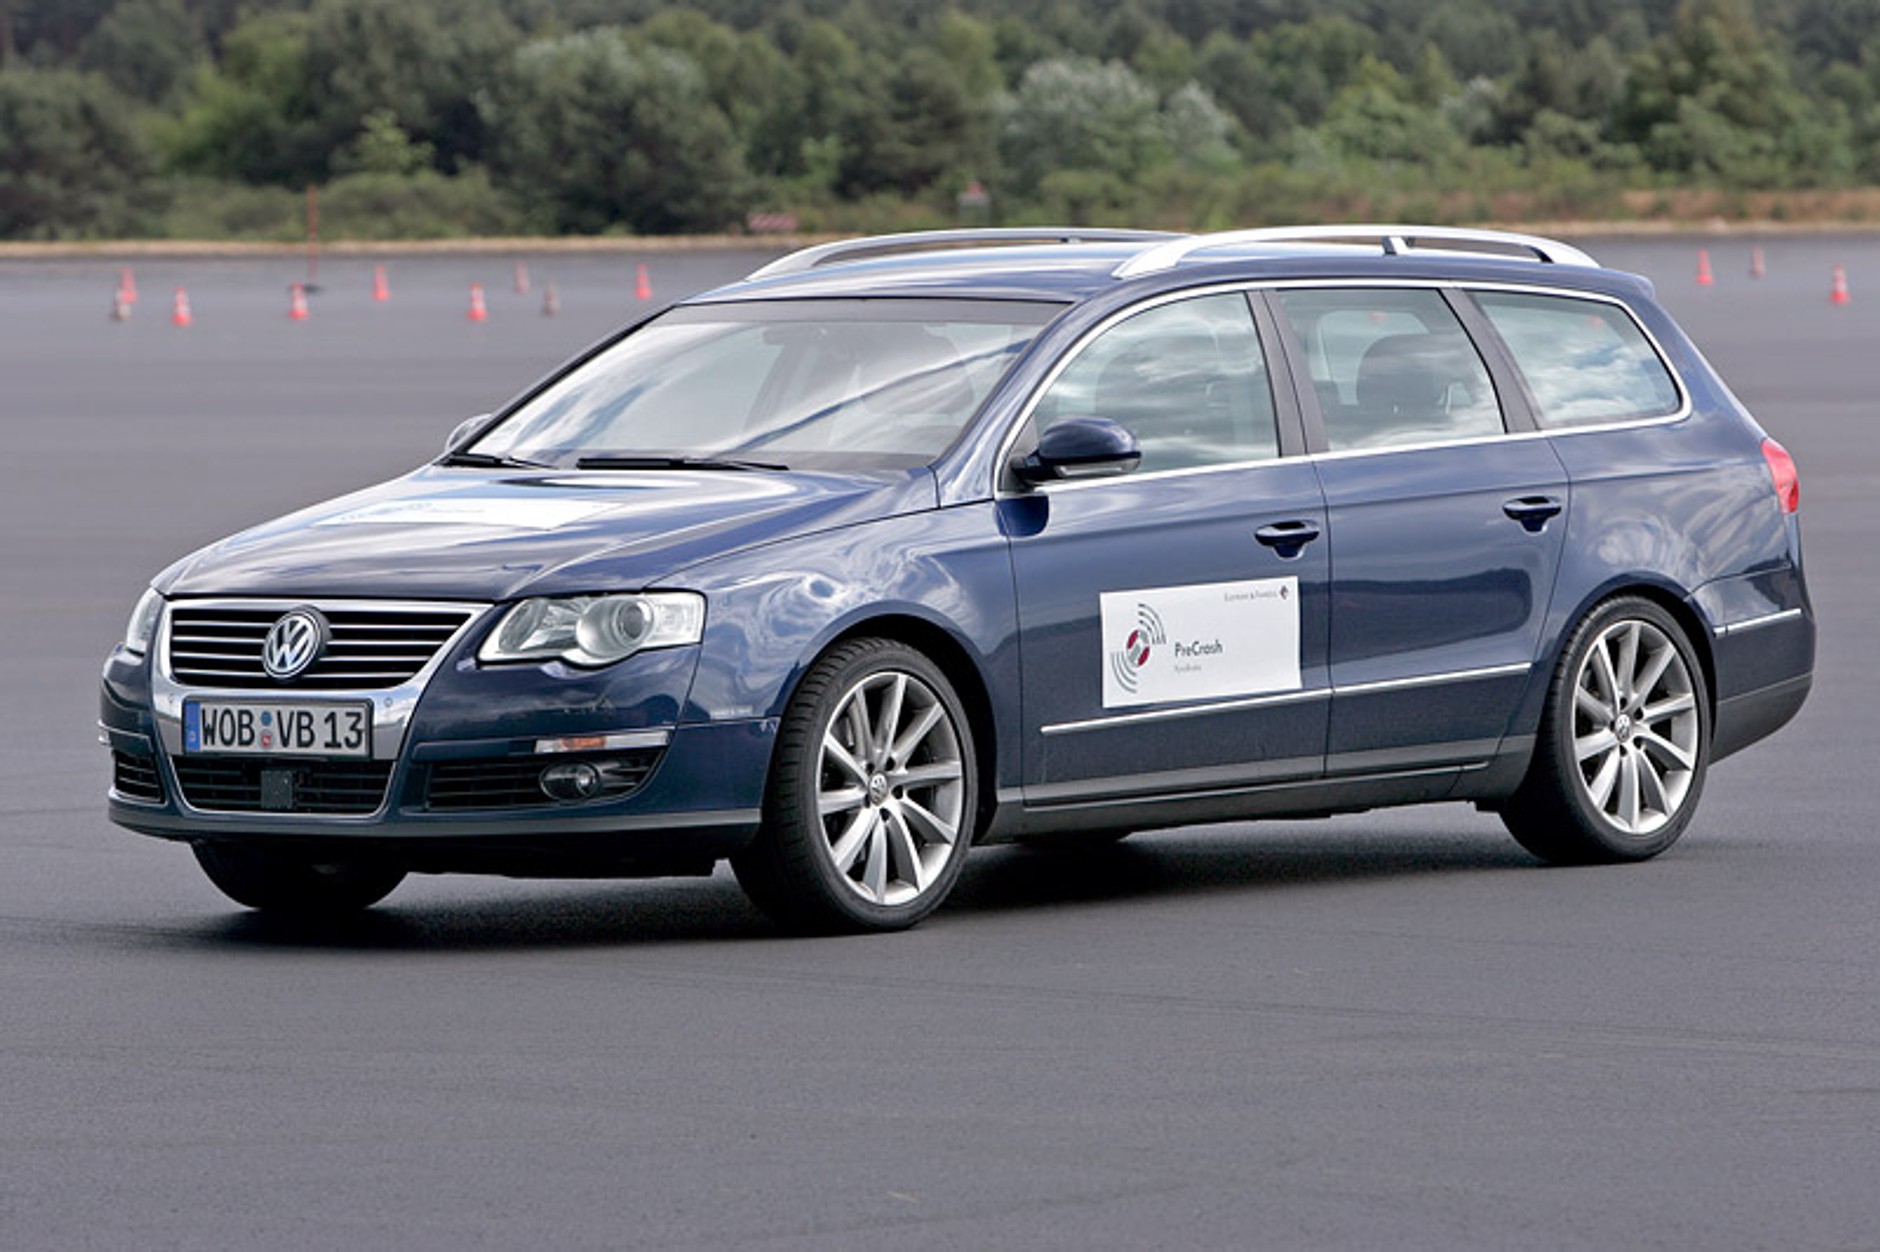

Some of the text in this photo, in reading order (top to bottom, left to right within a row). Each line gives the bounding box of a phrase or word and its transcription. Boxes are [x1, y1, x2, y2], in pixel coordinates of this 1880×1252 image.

[1174, 639, 1223, 657] PreCrash
[201, 708, 363, 750] WOB VB 13
